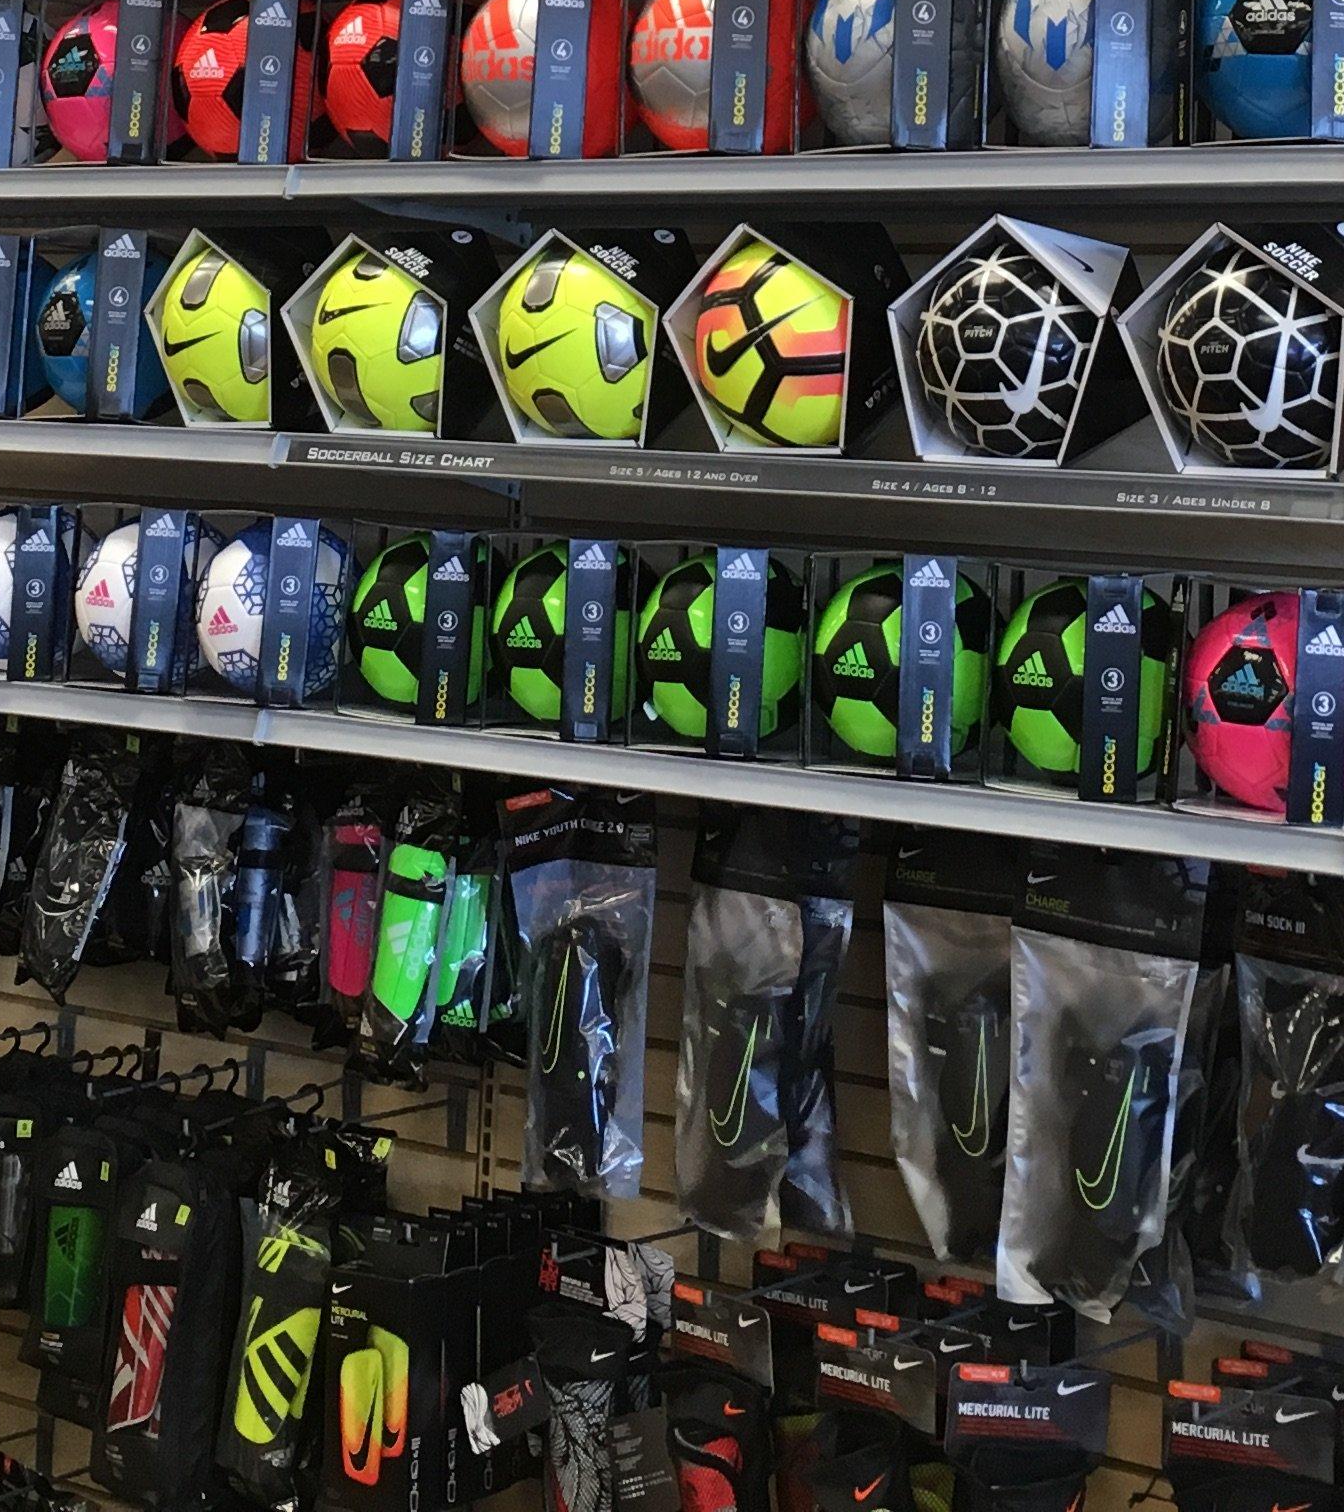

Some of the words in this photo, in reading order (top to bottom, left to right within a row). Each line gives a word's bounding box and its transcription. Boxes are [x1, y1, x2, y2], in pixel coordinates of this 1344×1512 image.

[1113, 85, 1126, 142] soccer
[257, 112, 271, 162] soccer
[384, 247, 429, 279] SOCCER
[404, 247, 433, 268] NIKE
[589, 244, 637, 281] SOCCER
[609, 245, 640, 268] NIKE
[1263, 241, 1319, 282] SOCCER
[1285, 242, 1322, 267] NIKE
[21, 543, 55, 552] adidas
[433, 572, 470, 582] adidas
[147, 621, 159, 667] soccer
[833, 664, 874, 679] adidas
[1013, 672, 1053, 688] adidas
[584, 661, 596, 713] soccer
[728, 674, 741, 728] soccer
[820, 1361, 868, 1387] MERCURIAL
[870, 1374, 891, 1392] LITE
[958, 1403, 1020, 1419] MERCURIAL
[1024, 1407, 1050, 1420] LITE
[1172, 1422, 1239, 1445] MERCURIAL
[1242, 1433, 1270, 1448] LITE
